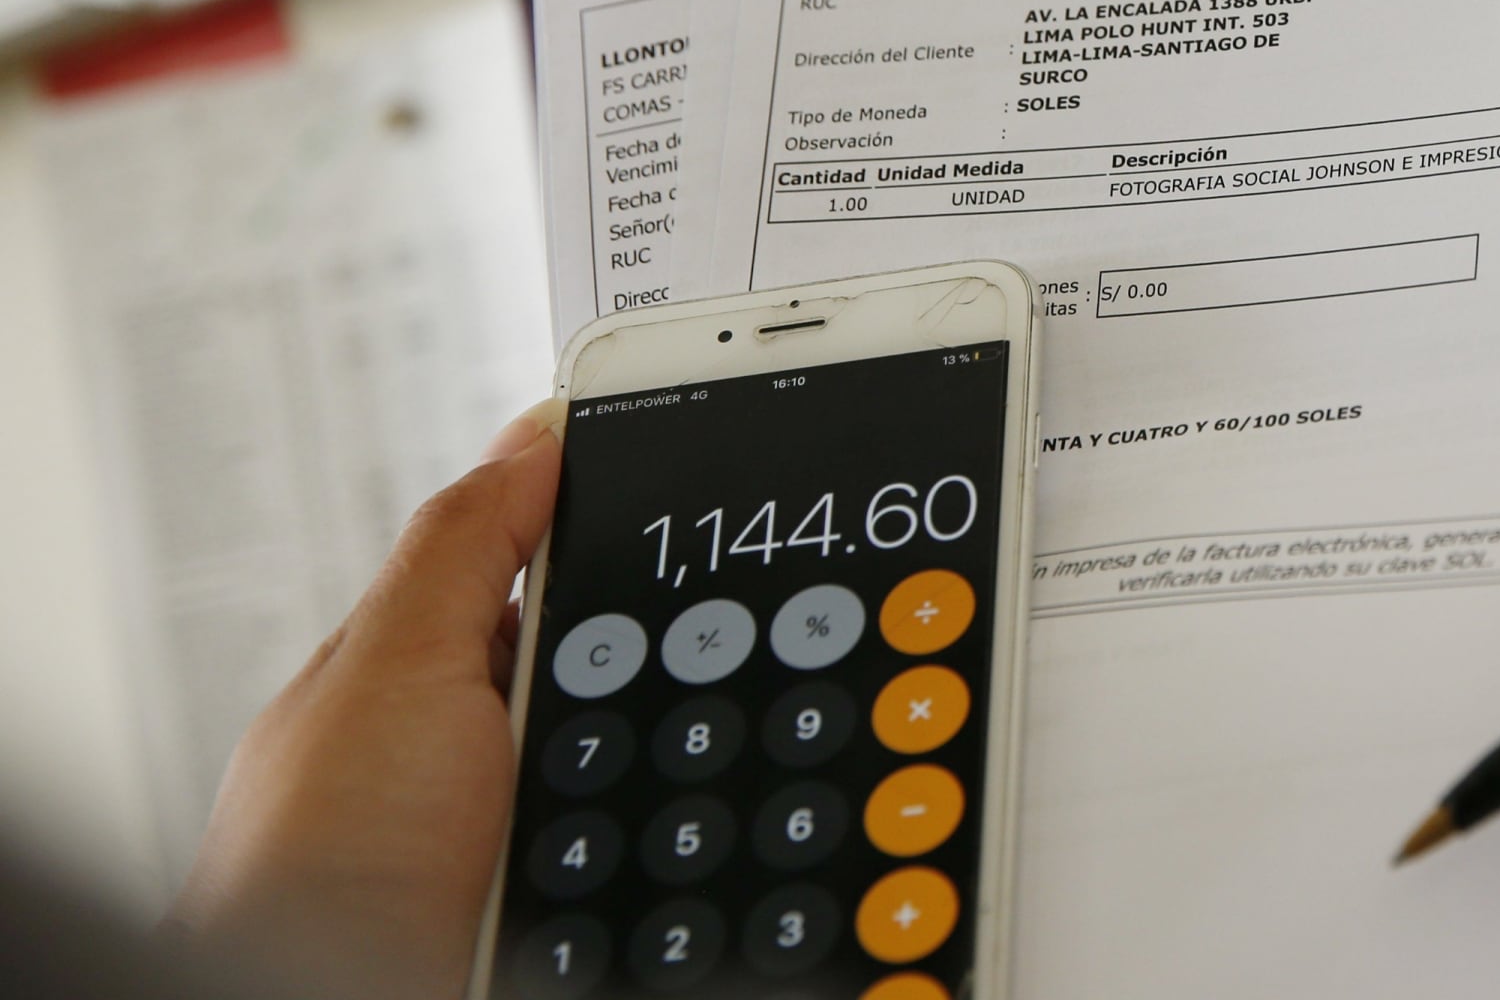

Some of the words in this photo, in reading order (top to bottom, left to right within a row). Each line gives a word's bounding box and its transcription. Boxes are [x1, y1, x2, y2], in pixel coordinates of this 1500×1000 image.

[1023, 28, 1074, 45] LIMA
[1080, 24, 1134, 41] POLO
[1141, 20, 1197, 37] HUNT
[1202, 16, 1245, 32] INT.
[1252, 12, 1290, 28] 503
[1025, 9, 1057, 24] AV.
[1064, 6, 1089, 21] LA
[794, 49, 874, 67] Dirección
[882, 48, 907, 63] del
[914, 44, 975, 61] Cliente
[1021, 37, 1247, 65] LIMA-LIMA-SANTIAGO
[1253, 33, 1280, 48] DE
[602, 78, 625, 96] FS
[1018, 68, 1088, 86] SURCO
[603, 95, 671, 123] COMAS
[788, 111, 825, 127] Tipo
[831, 109, 852, 123] de
[859, 105, 927, 121] Moneda
[1016, 95, 1081, 113] SOLES
[605, 139, 659, 162] Fecha
[785, 131, 893, 151] Observación
[778, 169, 866, 187] Cantidad
[877, 164, 946, 182] Unidad
[953, 160, 1024, 178] Medida
[1111, 146, 1228, 170] Descripción
[829, 197, 868, 212] 1.00
[951, 189, 1025, 206] UNIDAD
[1109, 175, 1226, 197] FOTOGRAFIA
[1232, 168, 1300, 187] SOCIAL
[1305, 158, 1396, 180] JOHNSON
[1402, 155, 1412, 170] E
[608, 189, 662, 213] Fecha
[611, 247, 652, 270] RUC
[1101, 285, 1121, 303] S/
[1128, 282, 1168, 299] 0.00
[1045, 302, 1077, 316] itas
[596, 393, 681, 415] ENTELPOWER
[690, 390, 709, 401] 4G
[772, 376, 806, 390] 16:10
[942, 355, 957, 365] 13
[959, 353, 970, 363] %
[1090, 434, 1102, 447] Y
[1108, 423, 1188, 445] CUATRO
[1196, 421, 1208, 433] Y
[1213, 412, 1291, 433] 60/100
[1296, 405, 1363, 425] SOLES
[643, 475, 978, 588] 1,144.60
[1053, 555, 1136, 581] impresa
[1142, 550, 1171, 568] de
[1176, 546, 1196, 563] la
[1203, 542, 1282, 562] factura
[1118, 569, 1223, 593] verificarla
[1230, 559, 1338, 587] utilizando
[1344, 560, 1371, 577] su
[1378, 556, 1438, 574] clave
[589, 644, 611, 667] C
[806, 614, 829, 638] %
[578, 738, 601, 769] 7
[685, 723, 711, 755] 8
[796, 709, 822, 740] 9
[562, 838, 589, 870] 4
[674, 823, 702, 856] 5
[787, 808, 814, 841] 6
[553, 941, 573, 975] 1
[662, 926, 691, 962] 2
[777, 911, 805, 948] 3
